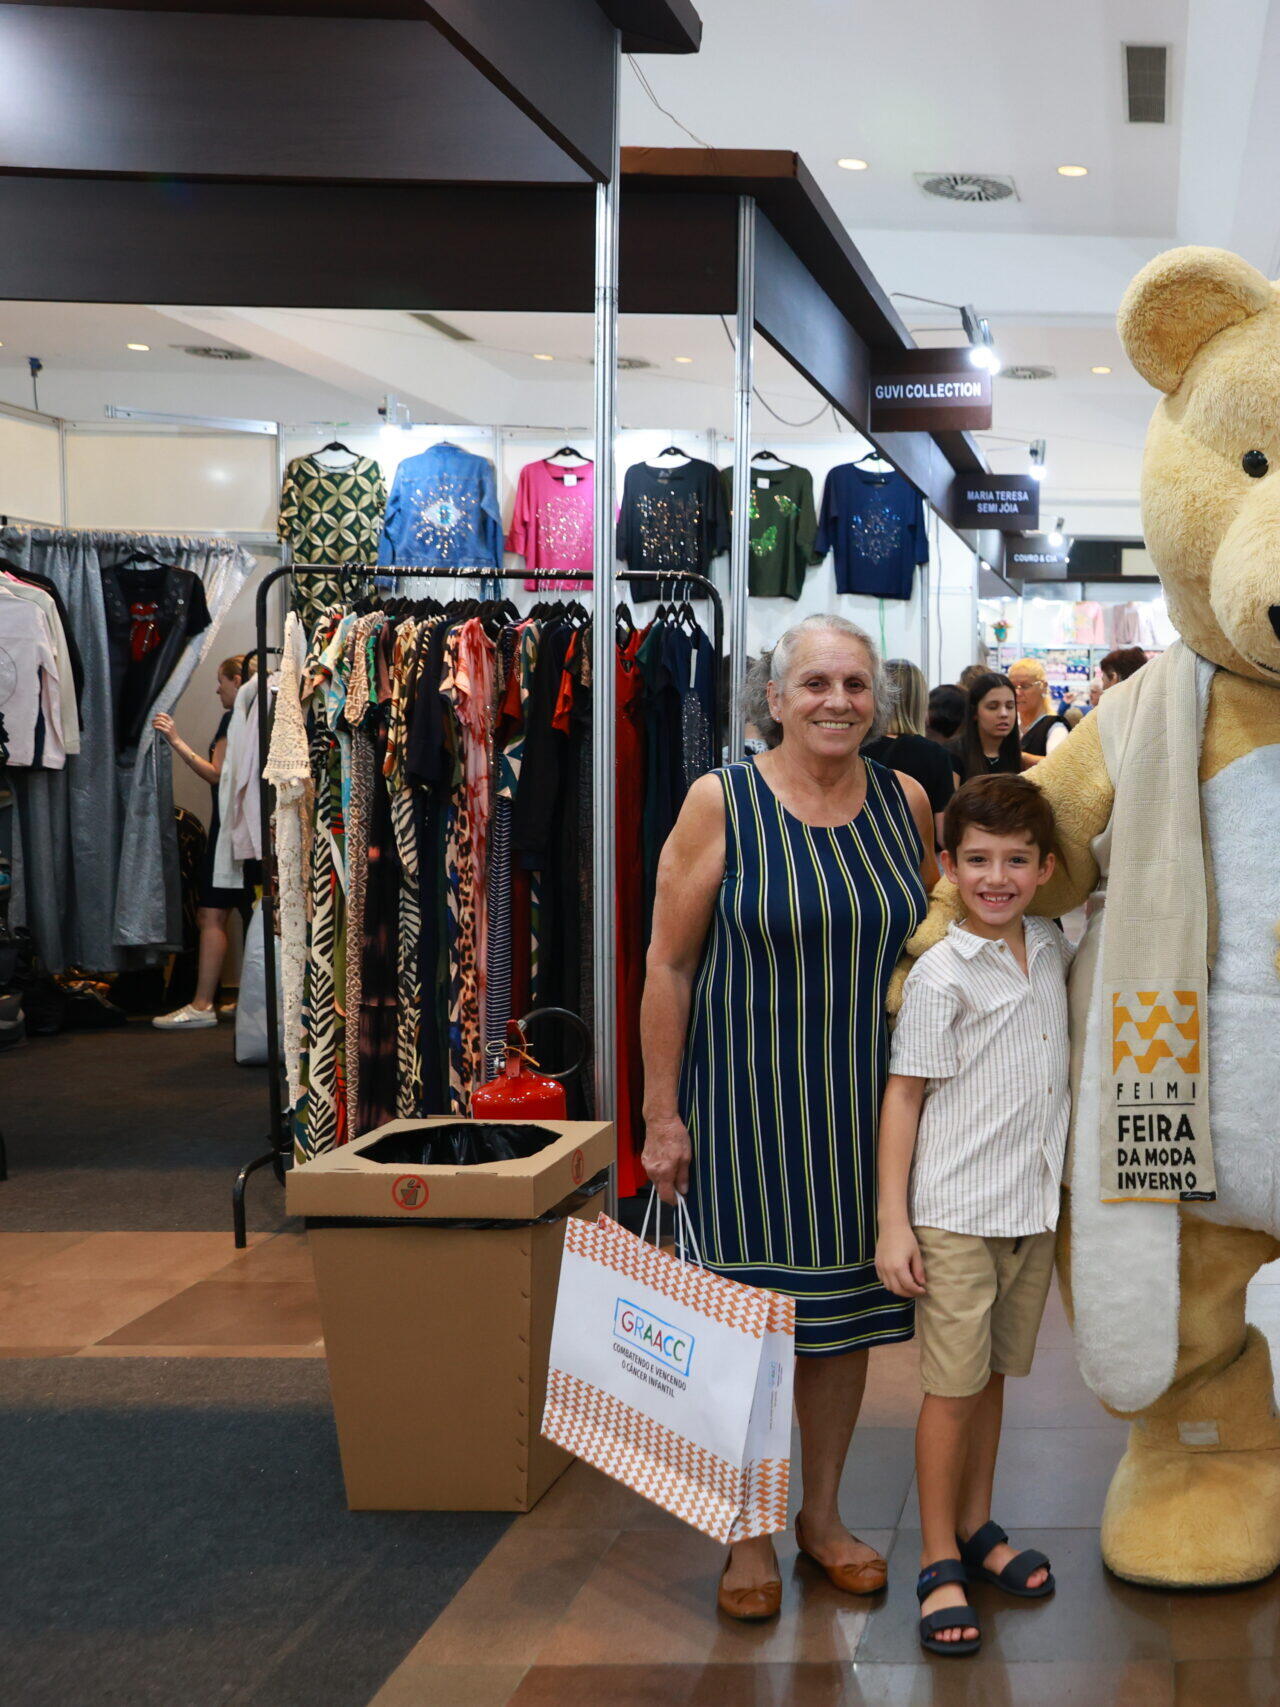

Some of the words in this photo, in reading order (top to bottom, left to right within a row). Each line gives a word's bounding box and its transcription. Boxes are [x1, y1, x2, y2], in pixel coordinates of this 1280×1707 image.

[875, 384, 903, 399] GUVI
[905, 382, 981, 398] COLLECTION
[967, 490, 994, 501] MARIA
[995, 490, 1029, 501] TERESA
[977, 503, 998, 513] SEMI
[999, 502, 1019, 513] JÓIA
[1013, 553, 1039, 562] COURO
[1117, 1082, 1196, 1100] FEIMI
[1118, 1114, 1195, 1142] FEIRA
[1117, 1148, 1141, 1166] DA
[1145, 1147, 1196, 1166] MODA
[1117, 1171, 1197, 1190] INVERNO
[621, 1311, 686, 1362] GRAACC
[613, 1342, 650, 1370] COMBATENDO
[655, 1365, 687, 1391] VENCENDO
[621, 1359, 627, 1369] O
[626, 1362, 648, 1382] CÂNCER
[648, 1375, 675, 1398] INFANTIL
